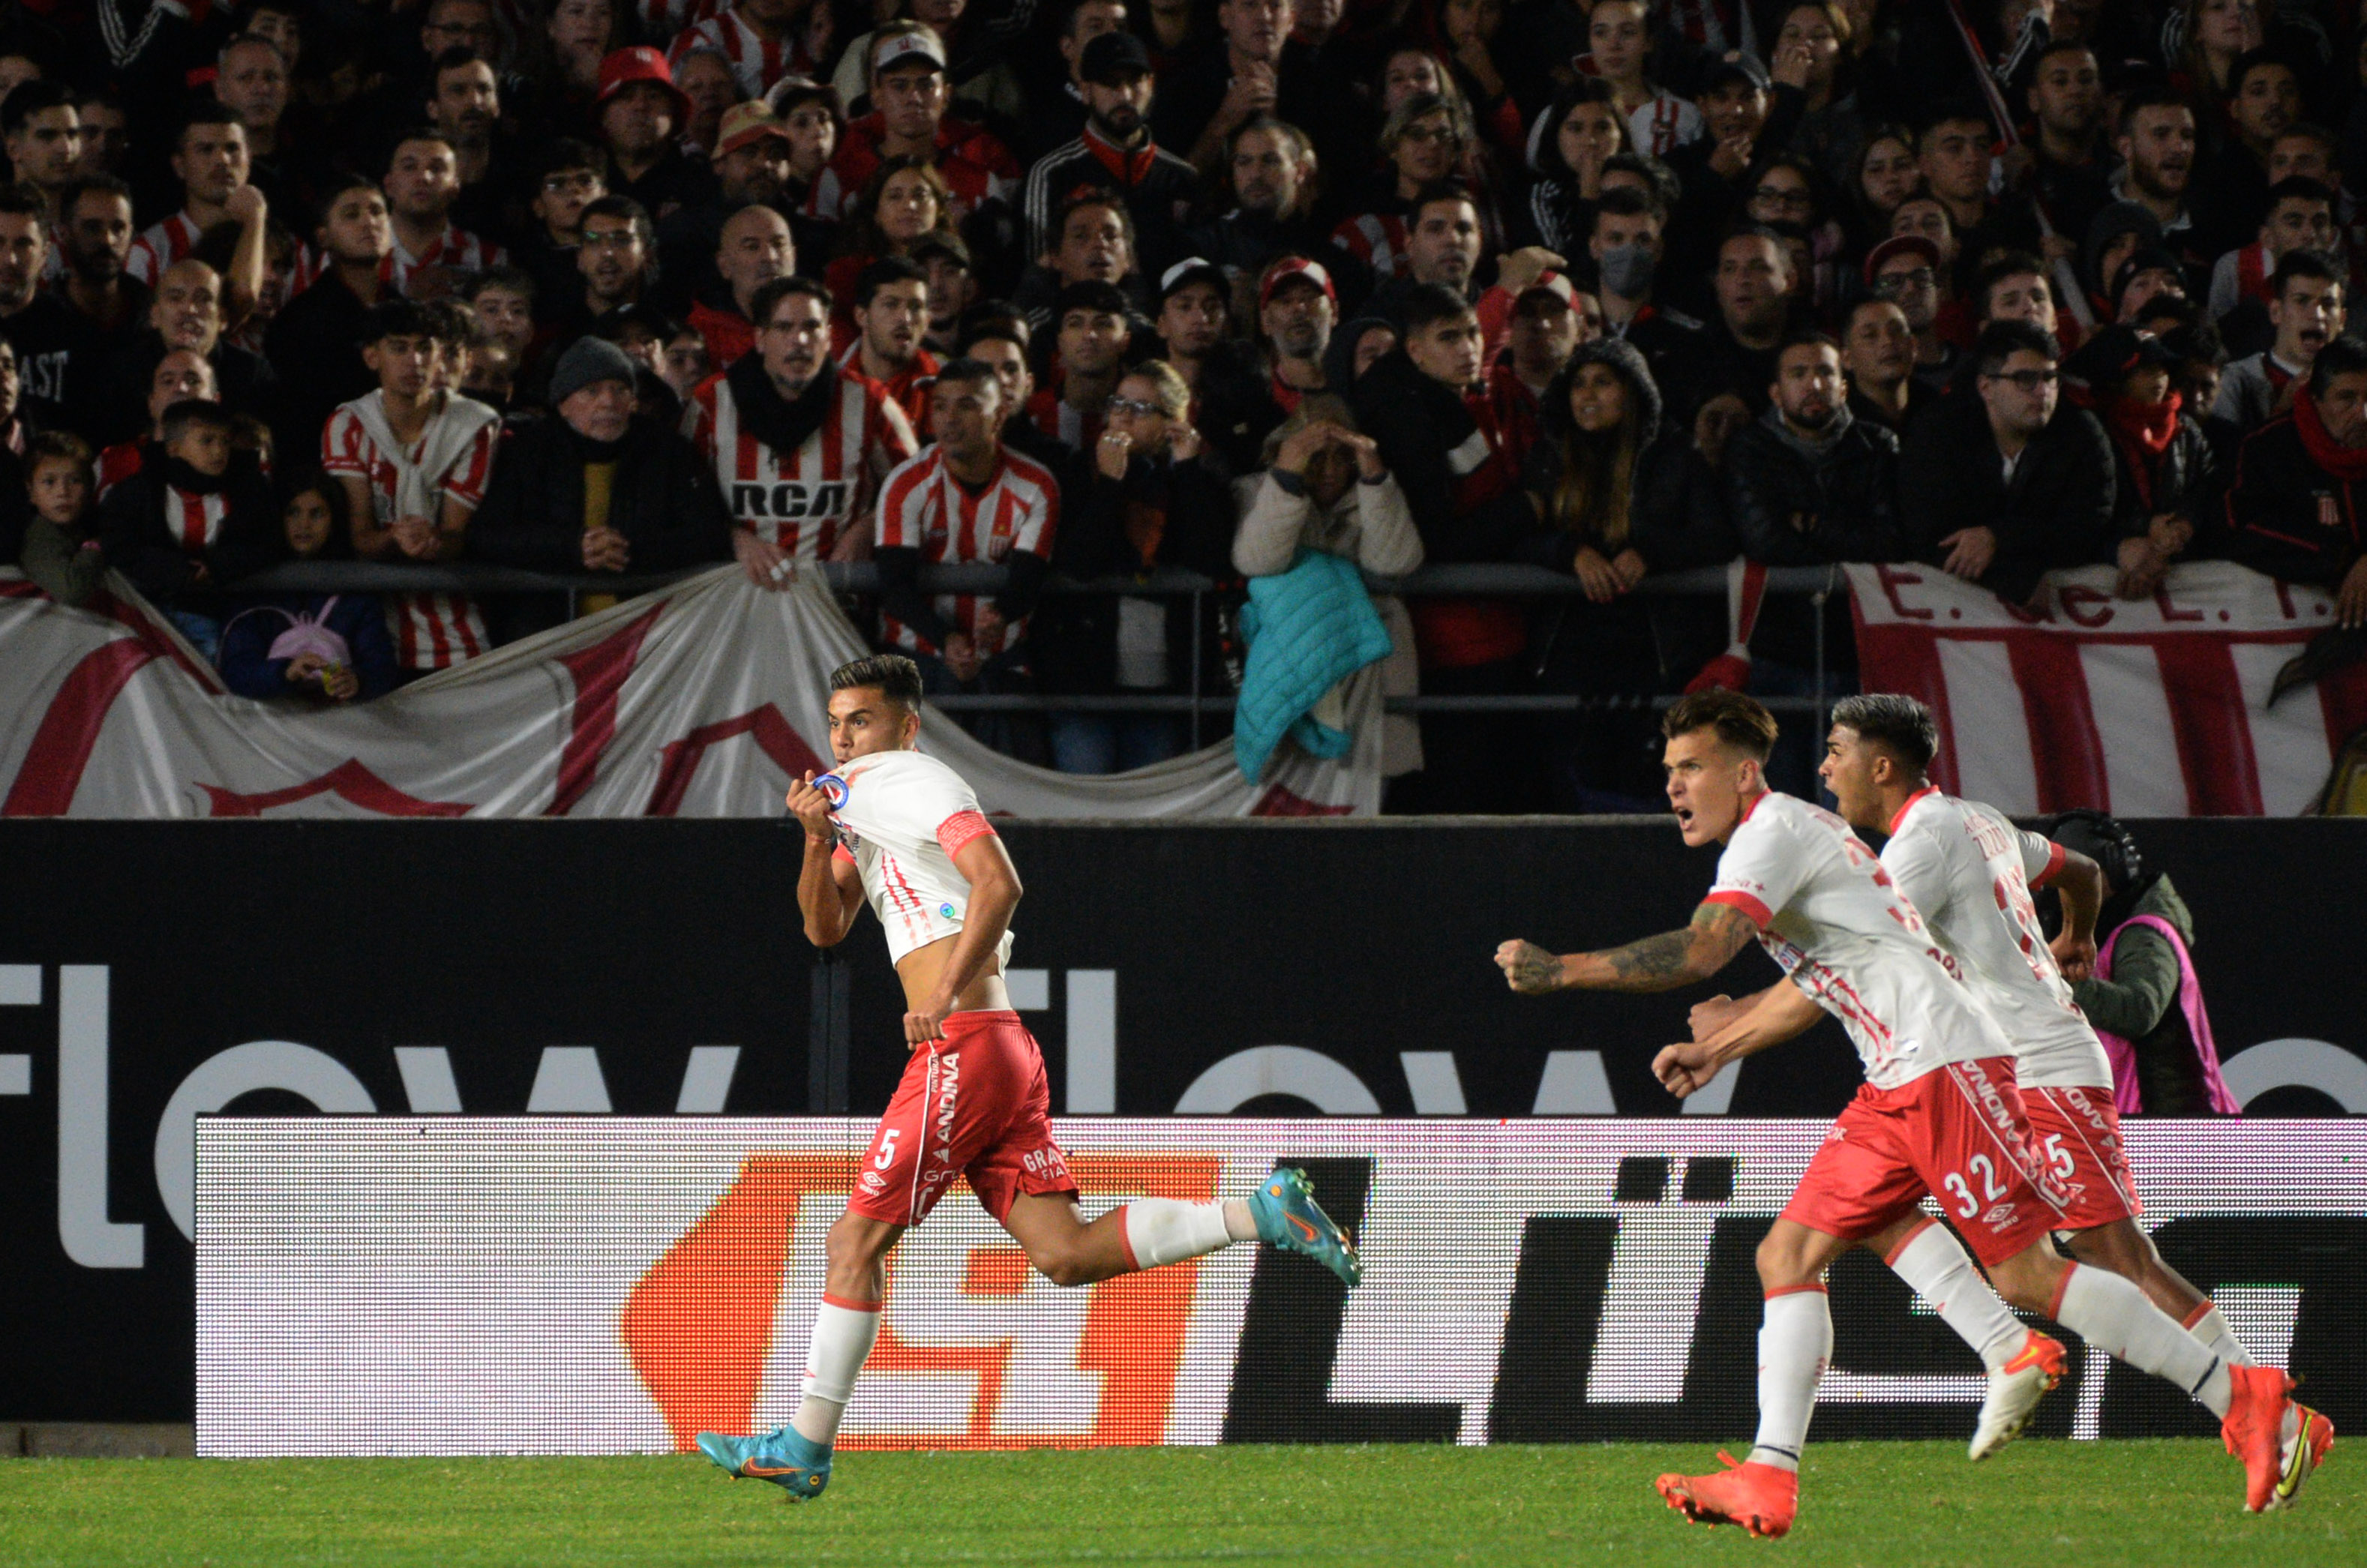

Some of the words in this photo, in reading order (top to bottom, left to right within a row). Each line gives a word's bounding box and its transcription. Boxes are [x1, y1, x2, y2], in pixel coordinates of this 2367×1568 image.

[733, 484, 846, 517] RCA
[937, 1052, 960, 1144] ANDINA
[874, 1129, 900, 1171] 5
[2044, 1132, 2076, 1179] 5
[1944, 1153, 2007, 1220] 32
